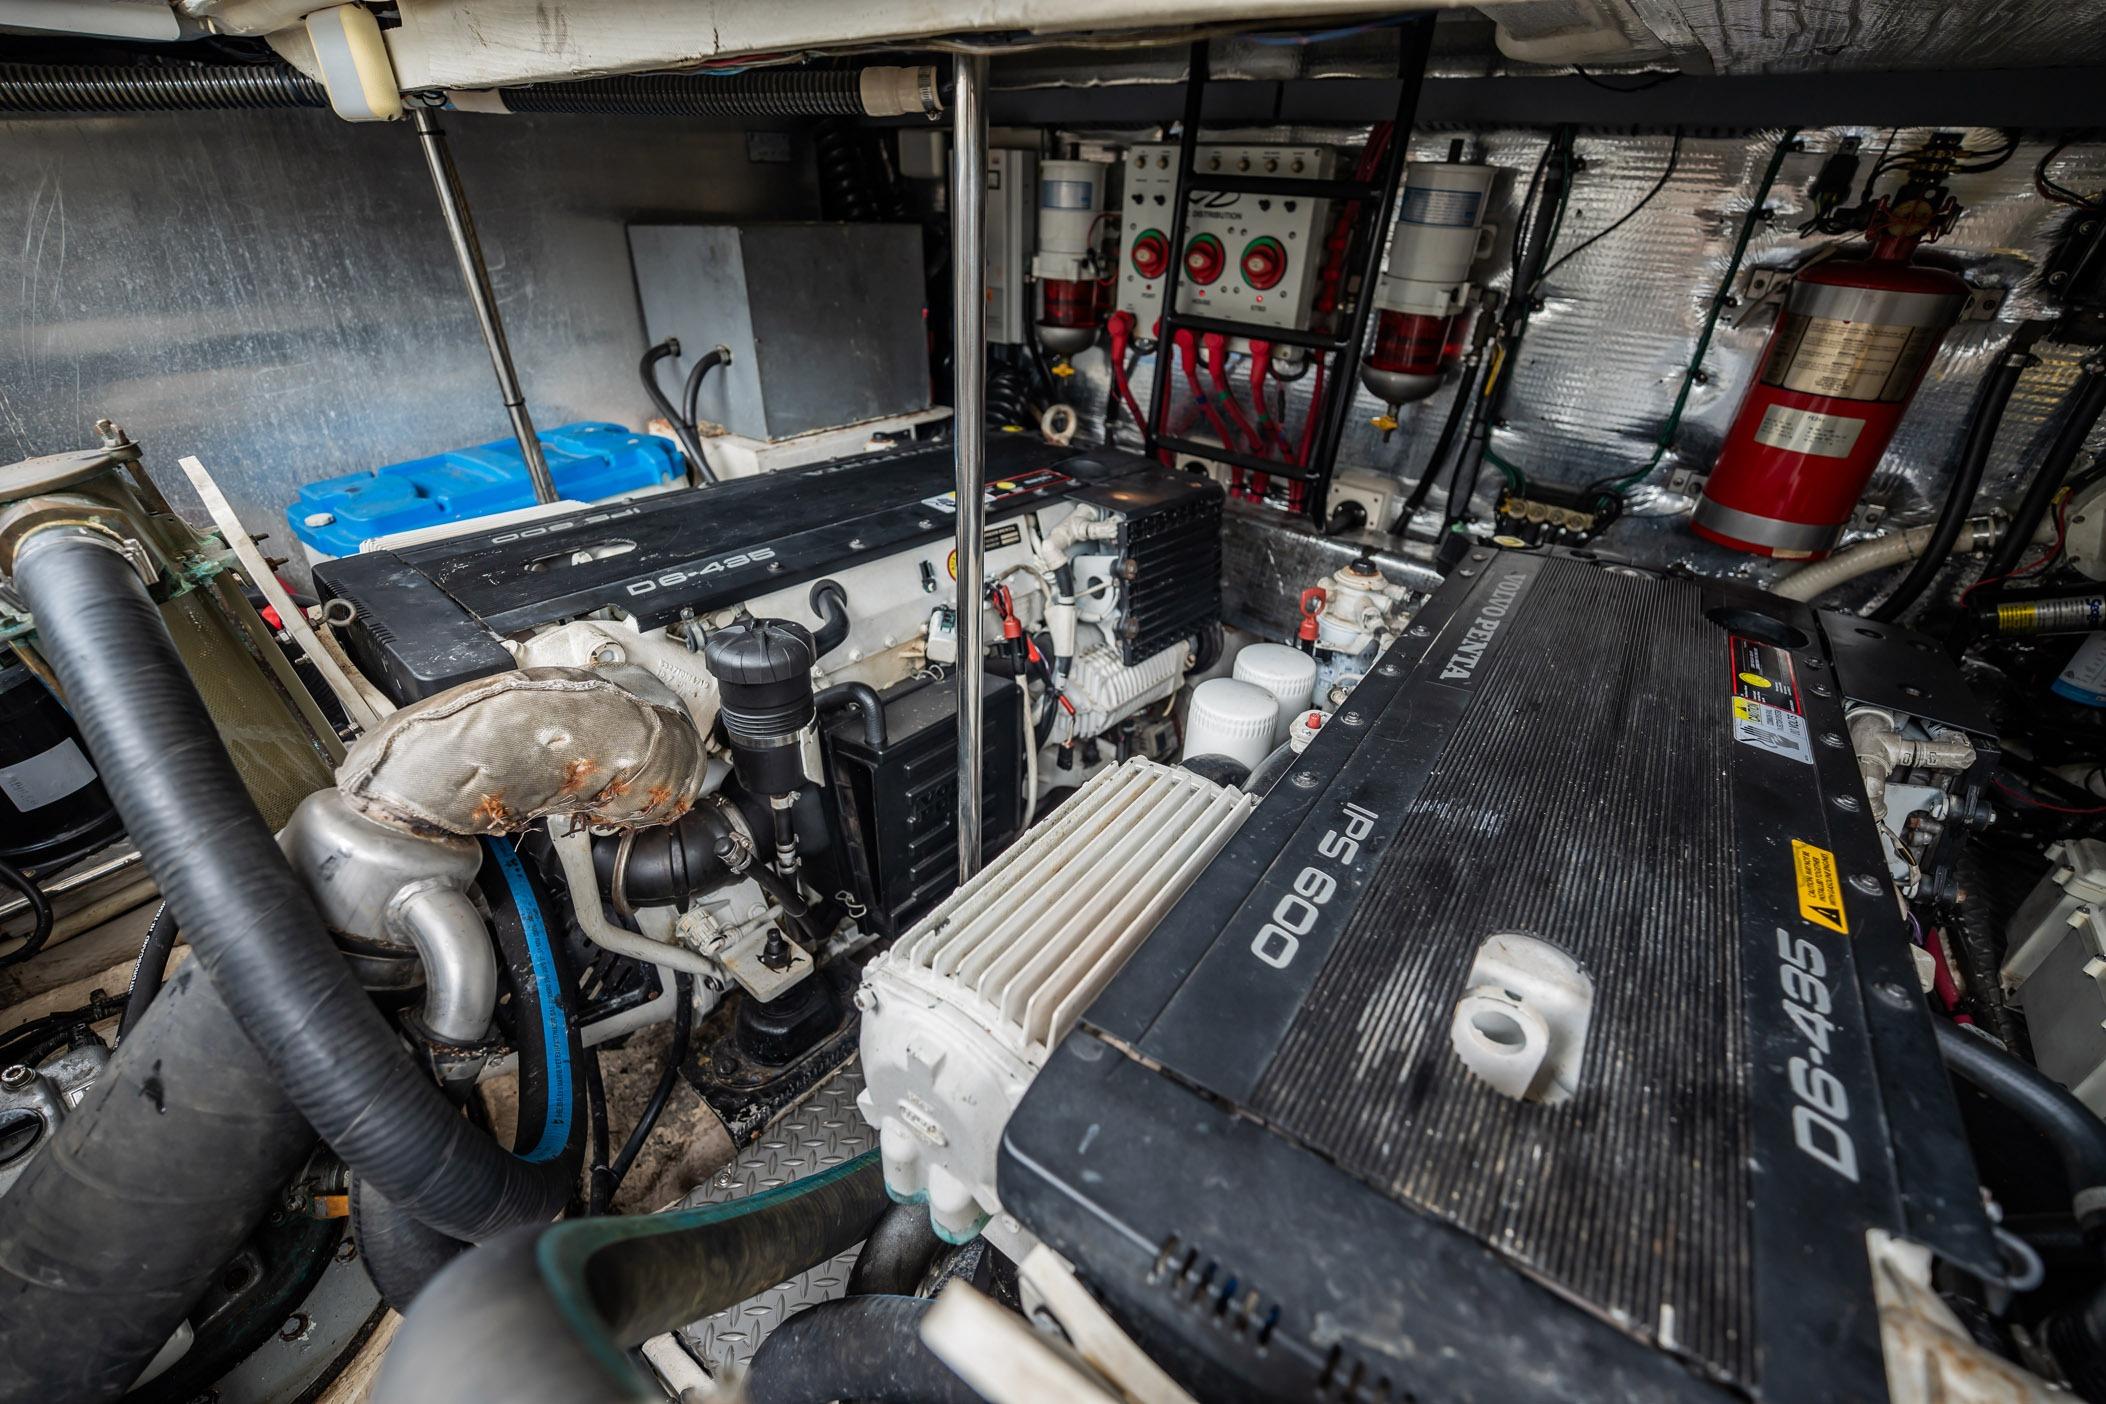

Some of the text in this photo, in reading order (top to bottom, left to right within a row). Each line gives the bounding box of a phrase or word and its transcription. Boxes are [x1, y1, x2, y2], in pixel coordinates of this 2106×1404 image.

[1192, 210, 1242, 220] DISTRIBUTION
[491, 506, 641, 544] IPS 600
[626, 547, 776, 596] D6-435
[1439, 574, 1527, 680] VOLVO PENTA
[1250, 802, 1379, 970] IPS 600
[128, 935, 150, 994] HYDROSCAND
[1776, 927, 1860, 1183] D6-435
